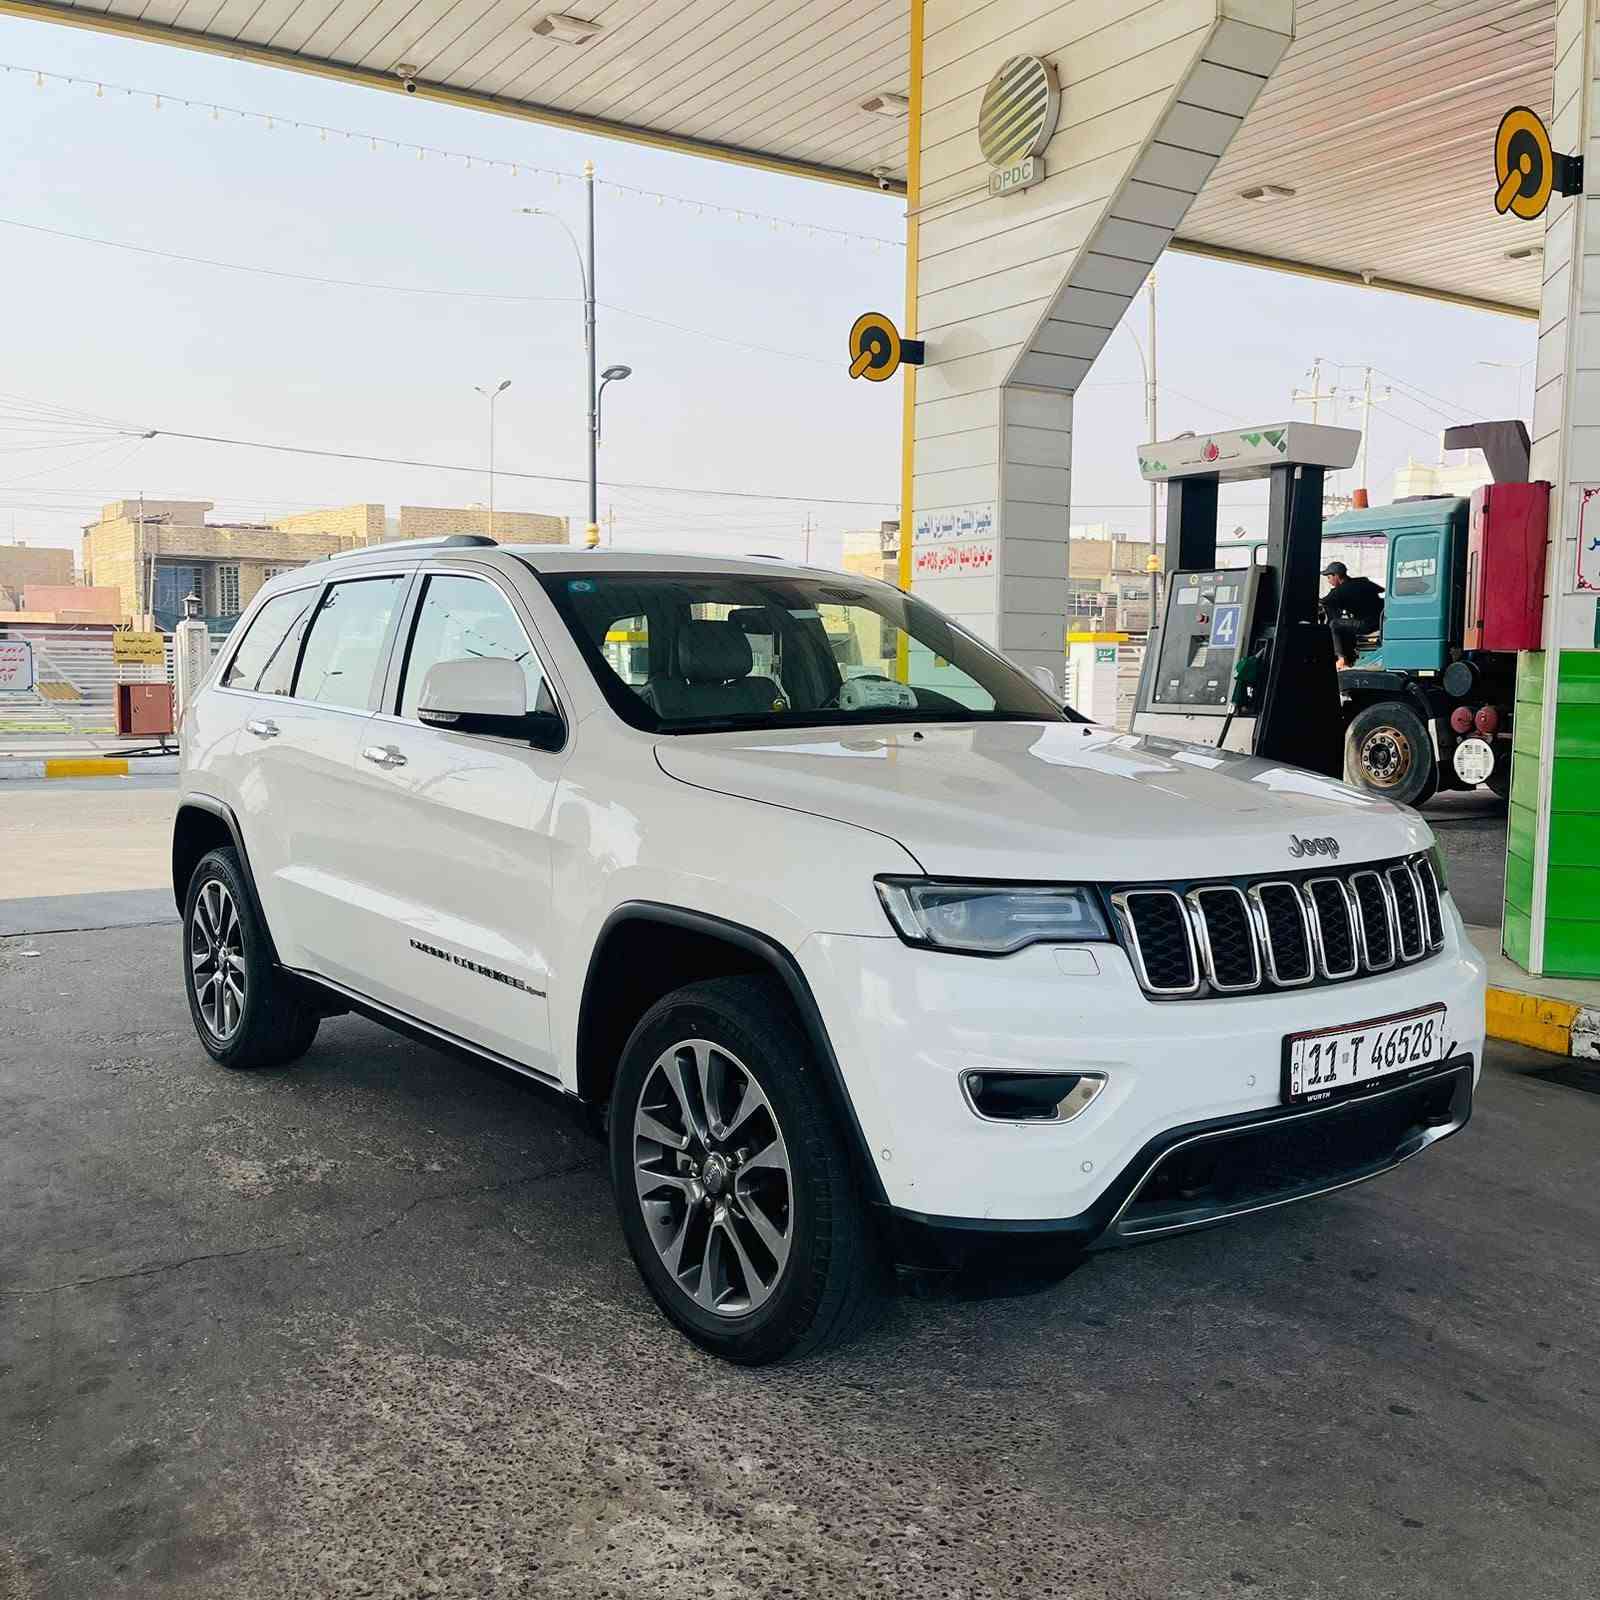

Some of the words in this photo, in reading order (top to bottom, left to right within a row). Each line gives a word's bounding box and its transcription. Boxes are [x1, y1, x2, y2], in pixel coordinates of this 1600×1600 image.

[992, 162, 1031, 191] OPDC
[1216, 610, 1234, 642] 4
[1288, 834, 1340, 859] Jeep
[1308, 1040, 1338, 1085] 11
[1350, 1035, 1365, 1077] T
[1370, 1019, 1434, 1071] 46528
